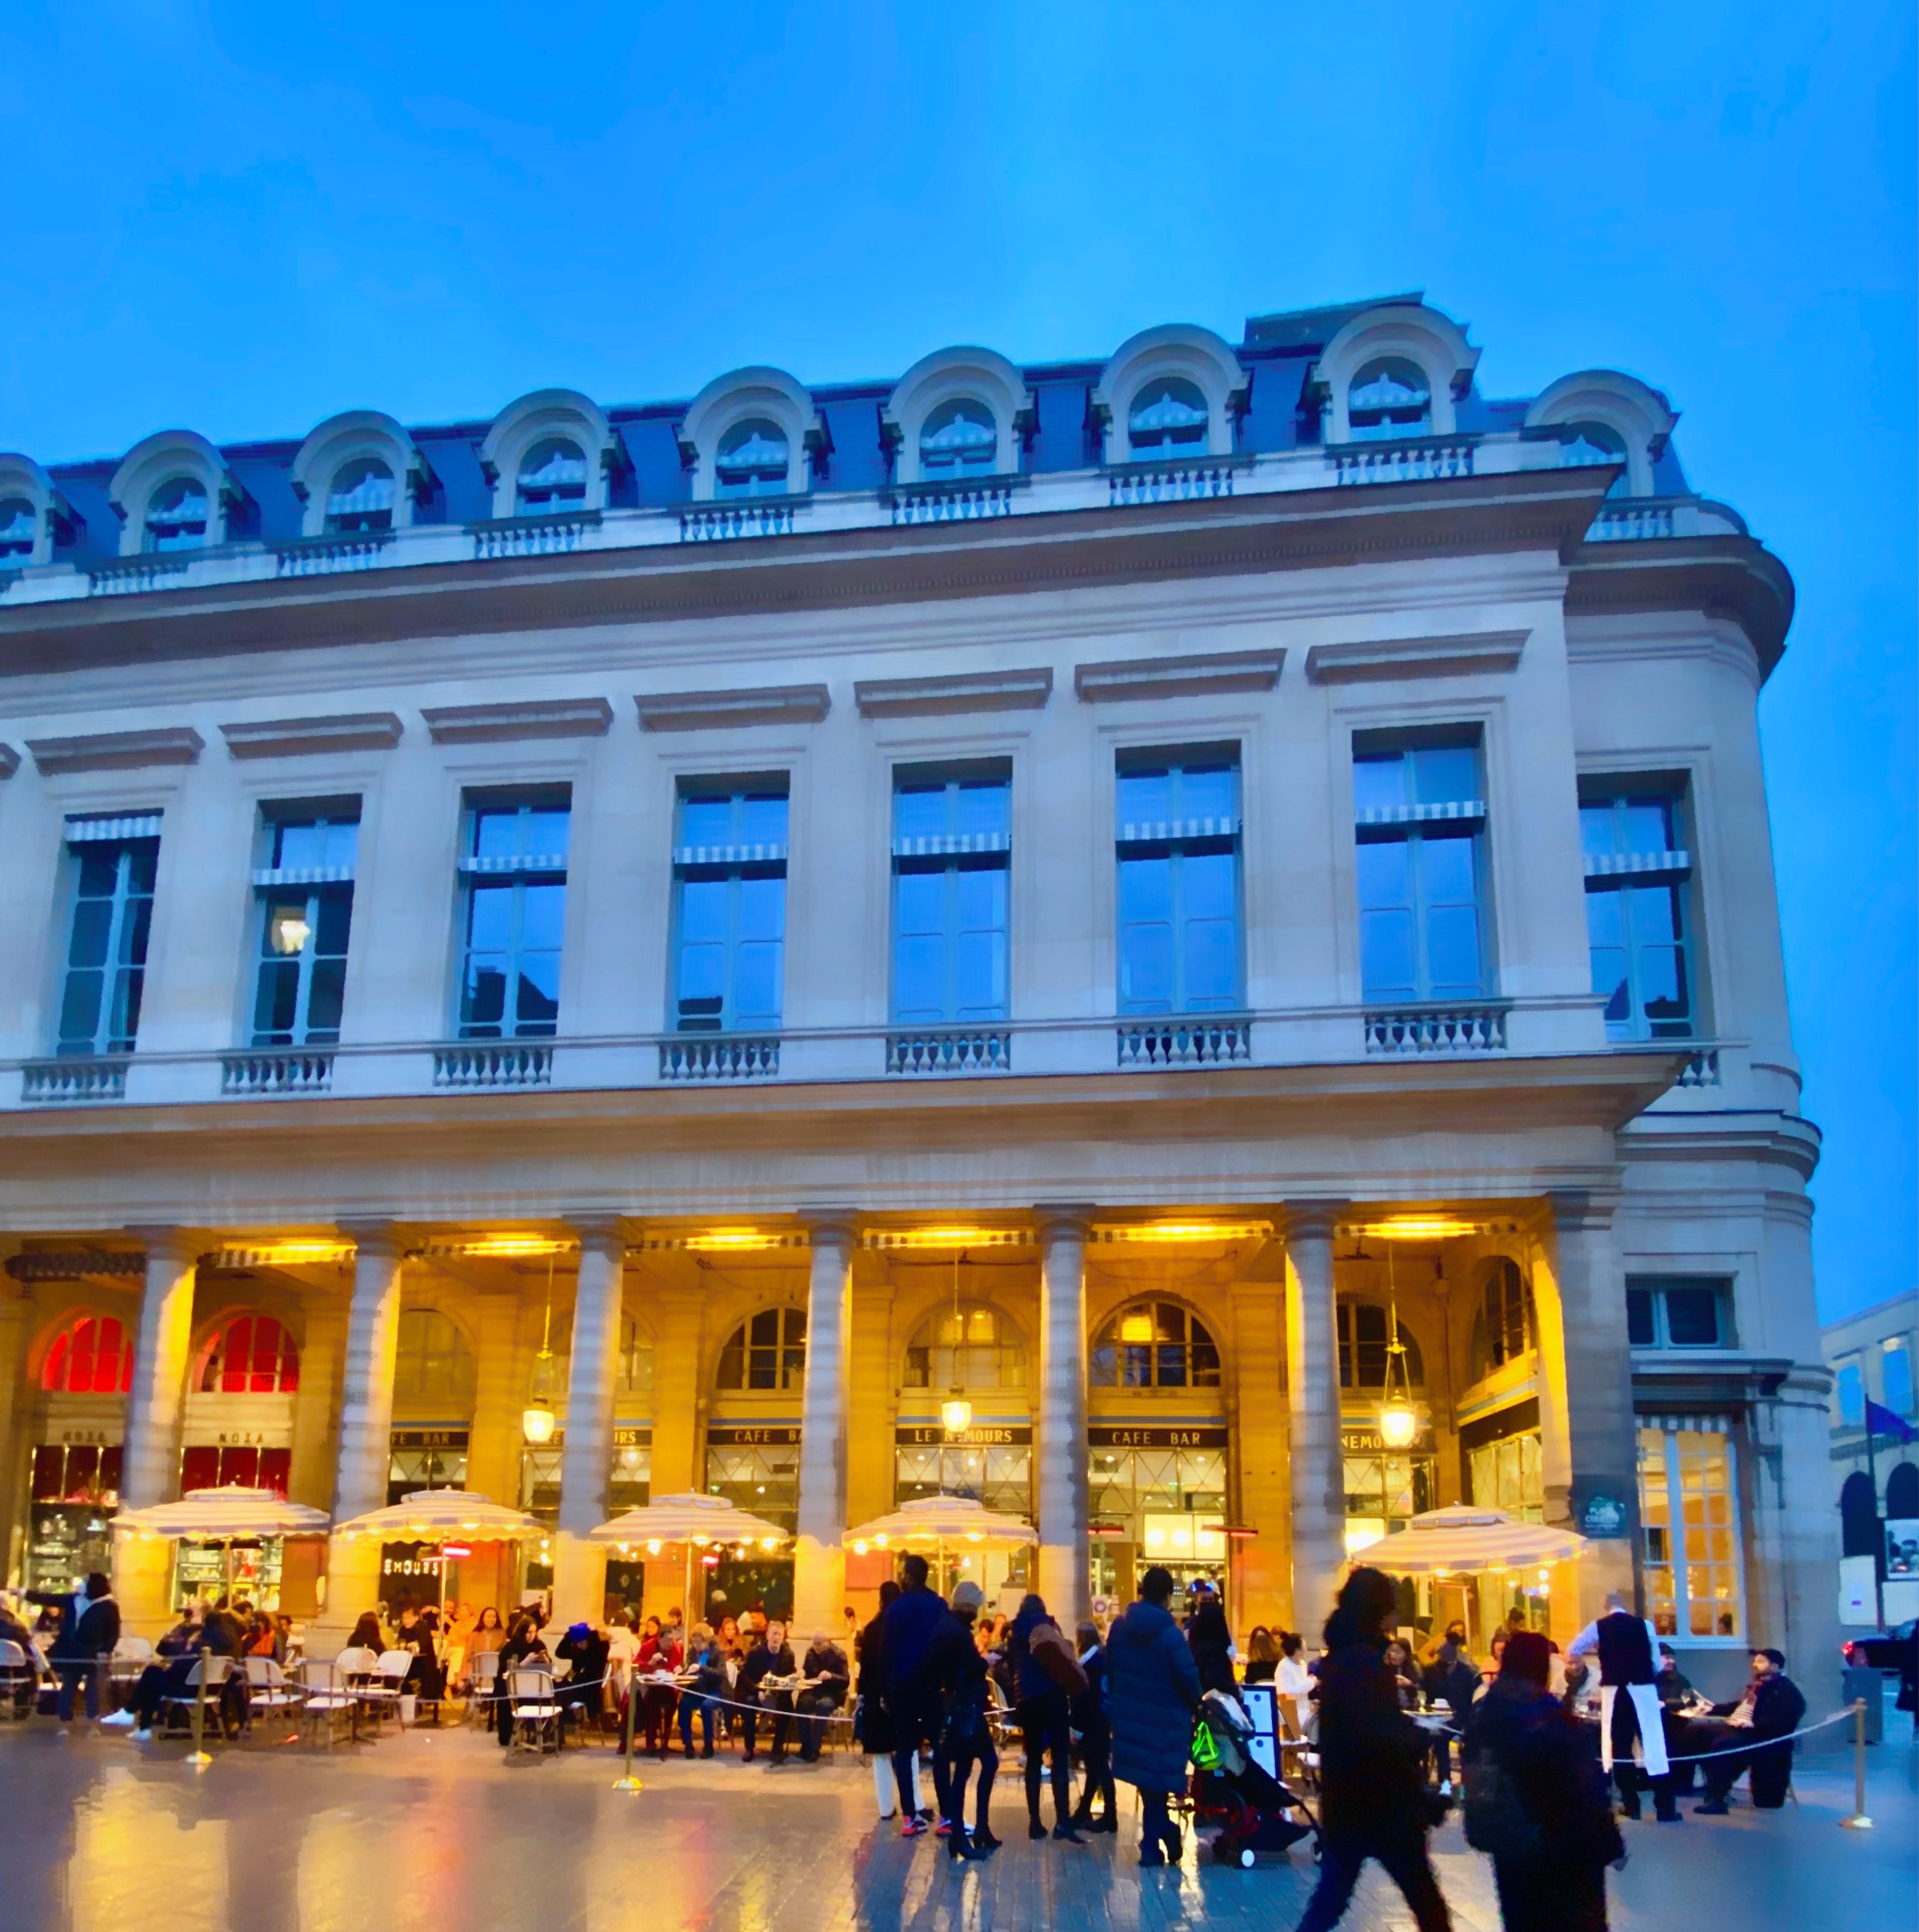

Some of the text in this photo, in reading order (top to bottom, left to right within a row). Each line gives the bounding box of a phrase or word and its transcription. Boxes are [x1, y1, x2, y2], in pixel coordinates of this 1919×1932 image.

[391, 1432, 450, 1445] FE BAR
[735, 1430, 771, 1442] CAFE
[915, 1430, 933, 1442] LE
[1112, 1431, 1200, 1445] CAFE BAR
[384, 1558, 439, 1576] EMOURS
